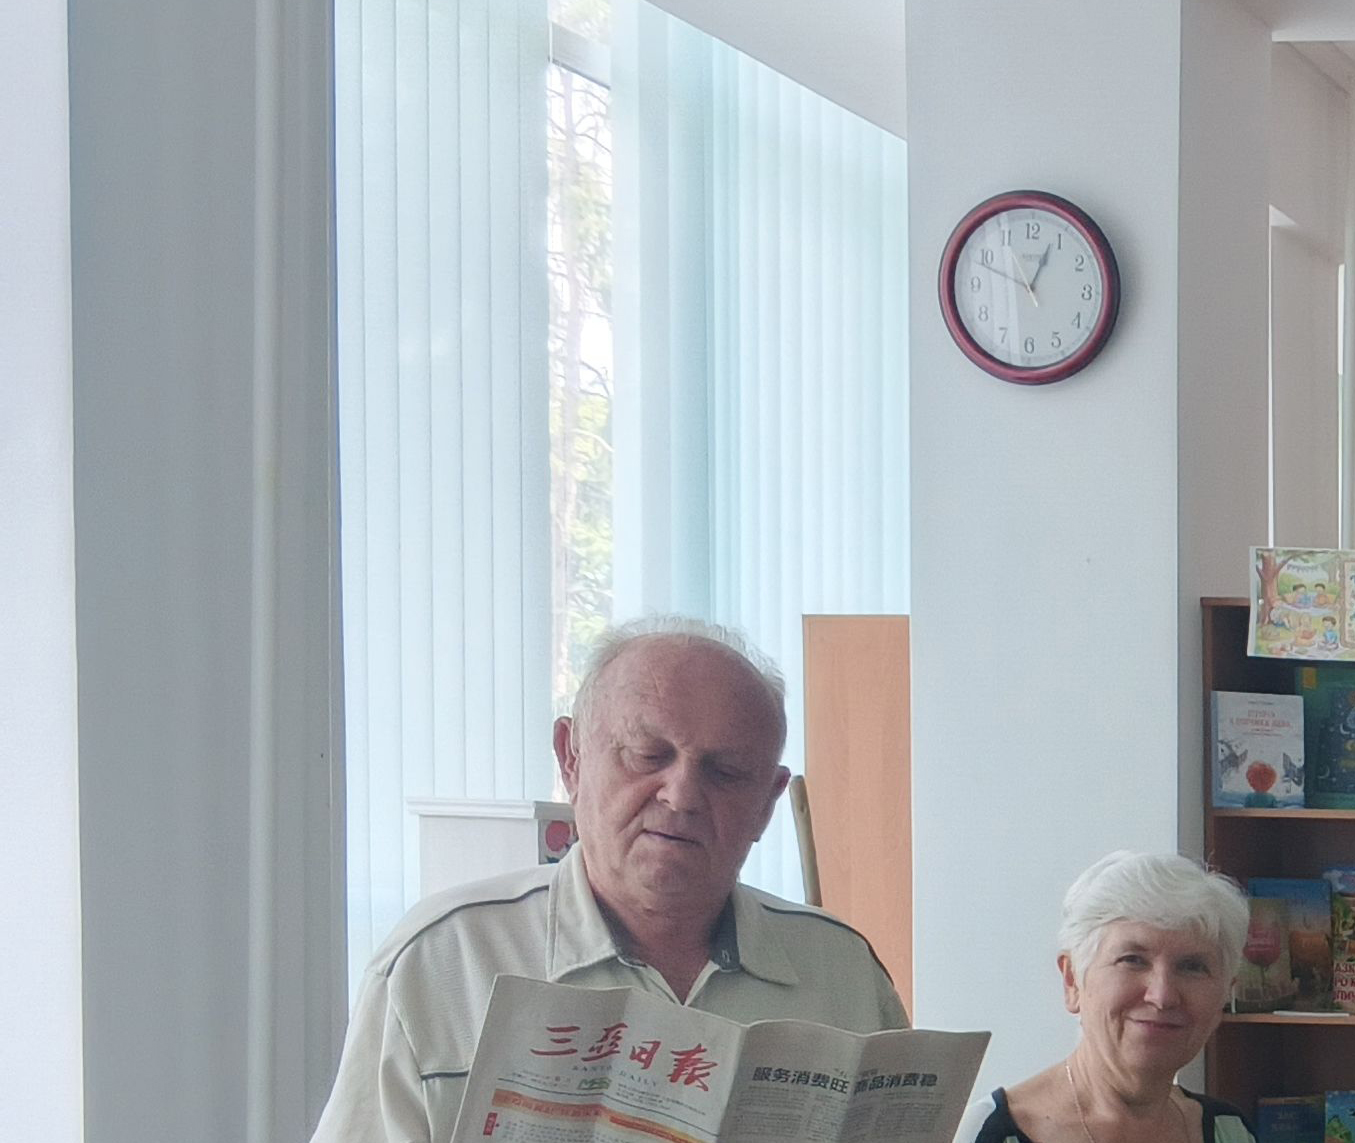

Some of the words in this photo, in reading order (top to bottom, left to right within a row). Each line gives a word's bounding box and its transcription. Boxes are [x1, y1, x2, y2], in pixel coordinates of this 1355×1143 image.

[1001, 229, 1012, 246] 11
[1024, 222, 1041, 240] 12
[1056, 233, 1063, 250] 1
[980, 249, 994, 266] 10
[1074, 255, 1084, 272] 2
[970, 276, 981, 293] 9
[1081, 284, 1093, 301] 3
[978, 305, 989, 322] 8
[1071, 312, 1081, 329] 4
[999, 327, 1008, 344] 7
[1051, 331, 1062, 349] 5
[1024, 336, 1035, 354] 6
[752, 1066, 850, 1094] 服务消费旺
